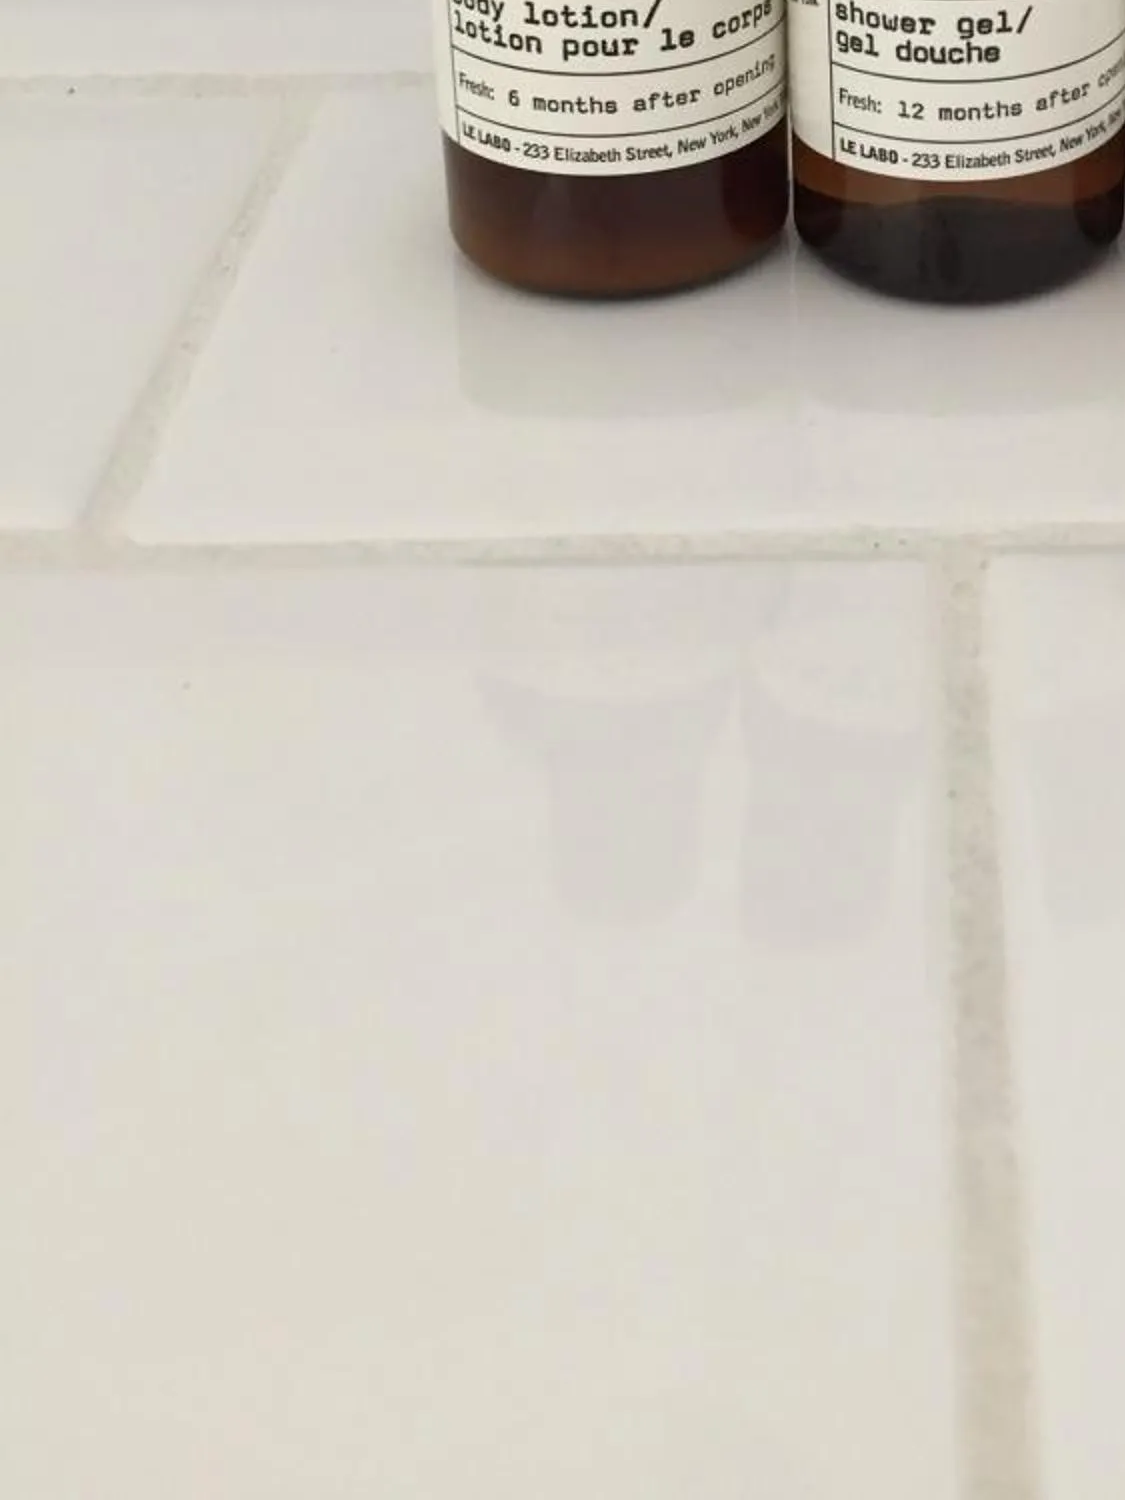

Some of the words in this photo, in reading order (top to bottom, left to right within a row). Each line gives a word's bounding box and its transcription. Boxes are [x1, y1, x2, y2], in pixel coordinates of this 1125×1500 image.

[454, 10, 542, 53] lotion
[562, 36, 639, 61] pour
[660, 28, 695, 52] le
[835, 0, 936, 36] shower
[957, 5, 1033, 38] gel/
[836, 29, 879, 57] gel
[896, 40, 1001, 64] douche
[459, 72, 495, 101] Fresh:
[508, 90, 520, 107] 6
[533, 94, 618, 114] months
[632, 87, 701, 112] after
[713, 52, 775, 98] opening
[839, 87, 882, 114] Fresh:
[898, 102, 925, 121] 12
[938, 102, 1022, 121] months
[1035, 81, 1091, 112] after
[462, 122, 477, 139] LE
[478, 129, 512, 152] LABO
[522, 142, 549, 159] 233
[555, 148, 621, 162] Elizabeth
[626, 144, 673, 161] Street,
[678, 131, 706, 154] New
[709, 118, 739, 145] York,
[839, 138, 855, 154] LE
[859, 144, 898, 164] LABO
[911, 152, 940, 168] 233
[945, 152, 1011, 169] Elizabeth
[1015, 141, 1056, 164] Street,
[1059, 128, 1086, 152] New
